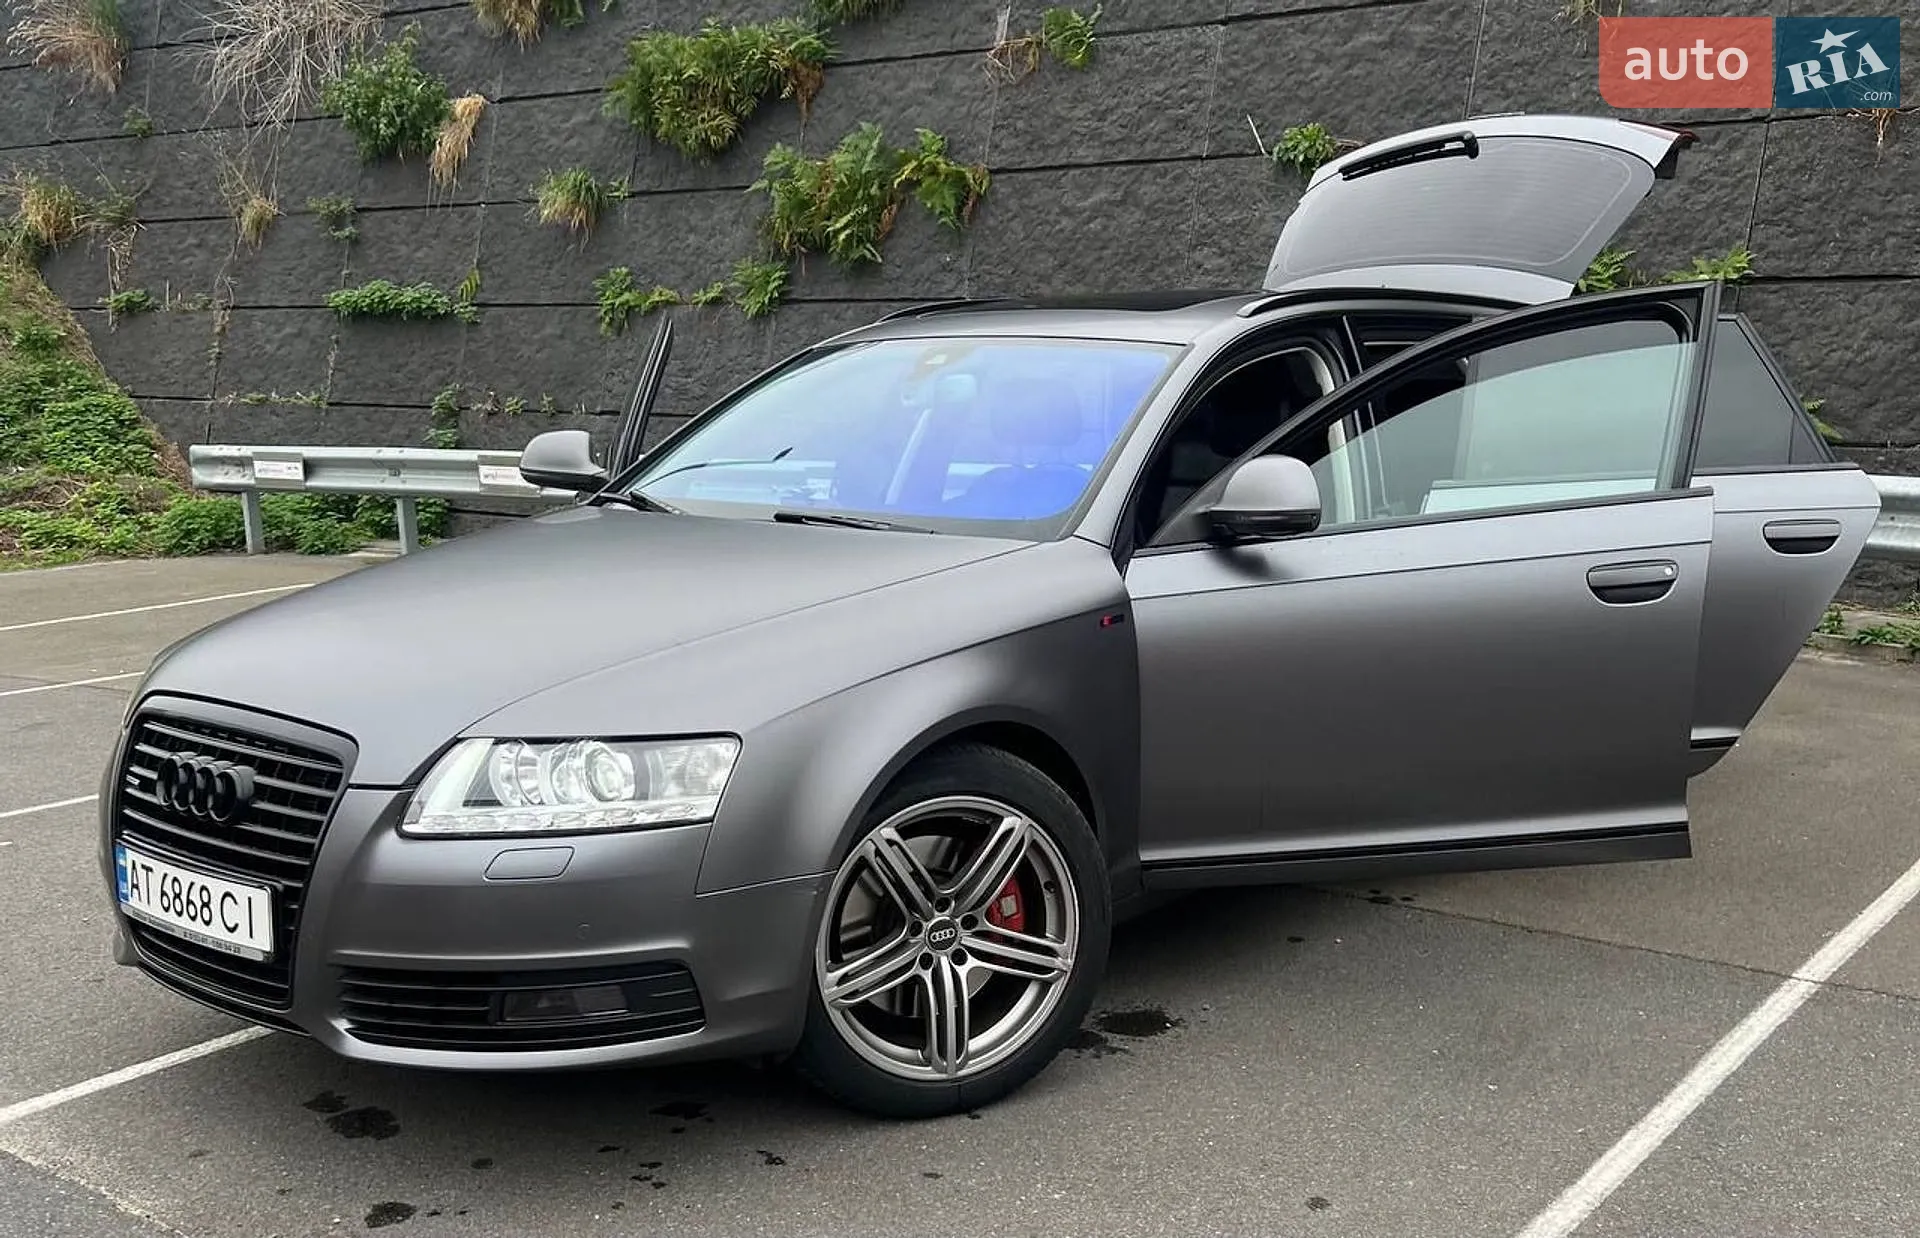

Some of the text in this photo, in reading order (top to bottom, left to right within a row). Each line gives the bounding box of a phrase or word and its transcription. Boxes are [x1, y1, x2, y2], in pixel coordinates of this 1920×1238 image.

[130, 859, 153, 906] AT
[160, 872, 213, 927] 6868
[220, 891, 254, 939] CI
